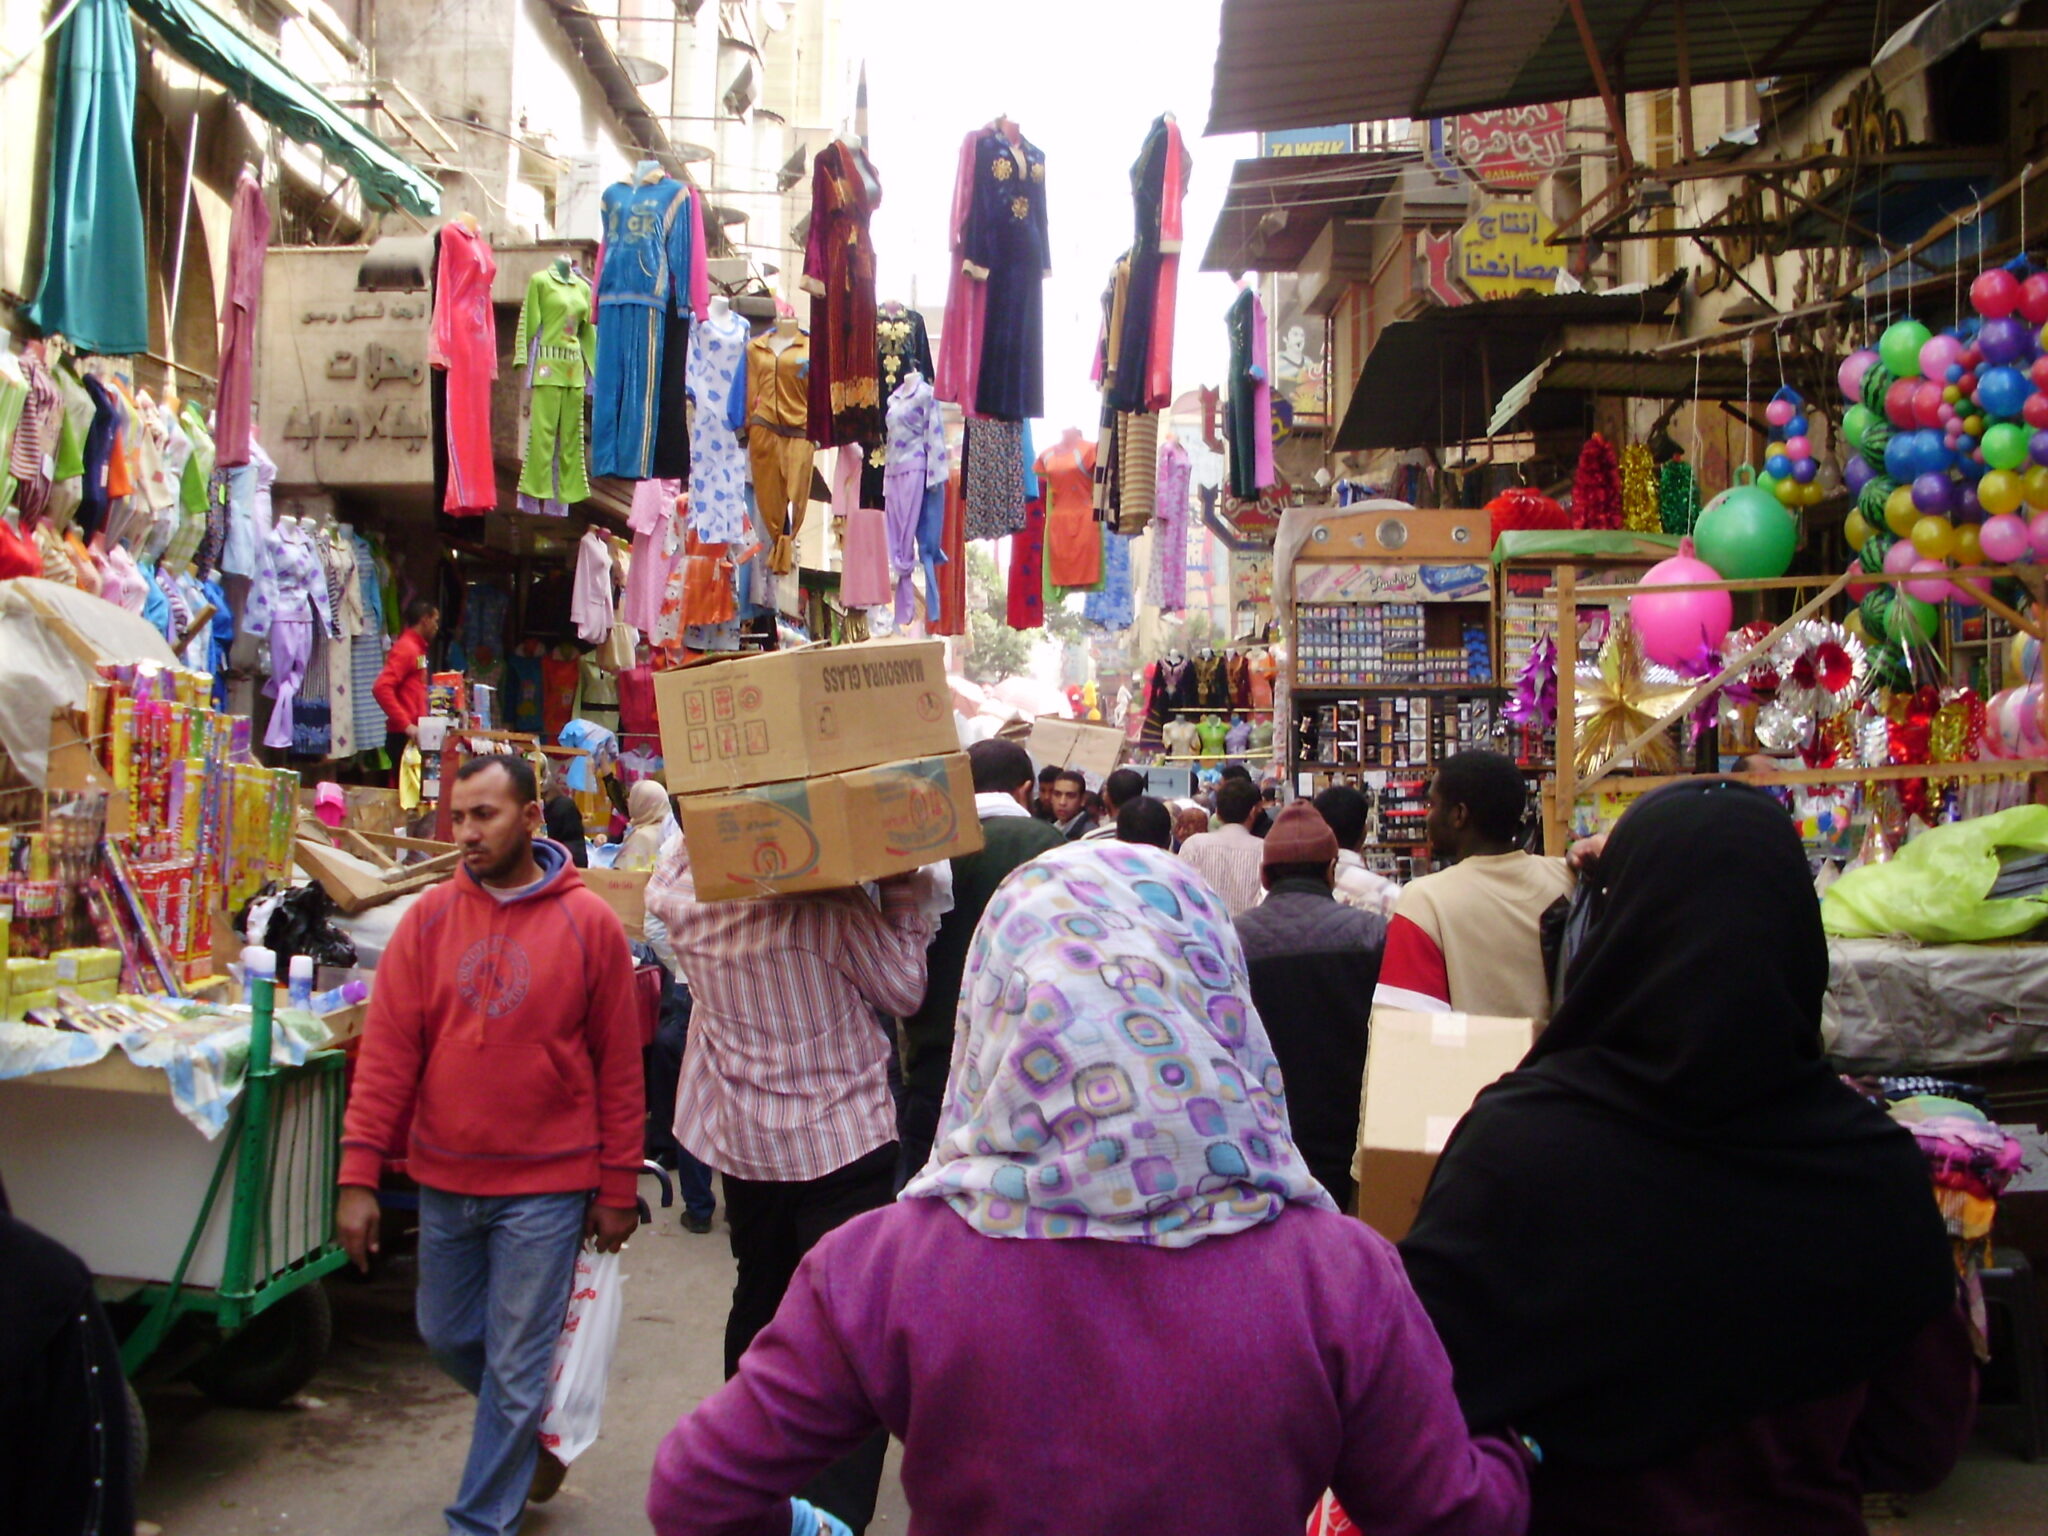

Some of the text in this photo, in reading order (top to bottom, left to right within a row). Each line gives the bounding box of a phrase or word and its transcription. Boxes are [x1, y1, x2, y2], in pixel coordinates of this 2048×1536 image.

[325, 342, 425, 390] محلات
[823, 658, 925, 693] MANSOURA GLASS
